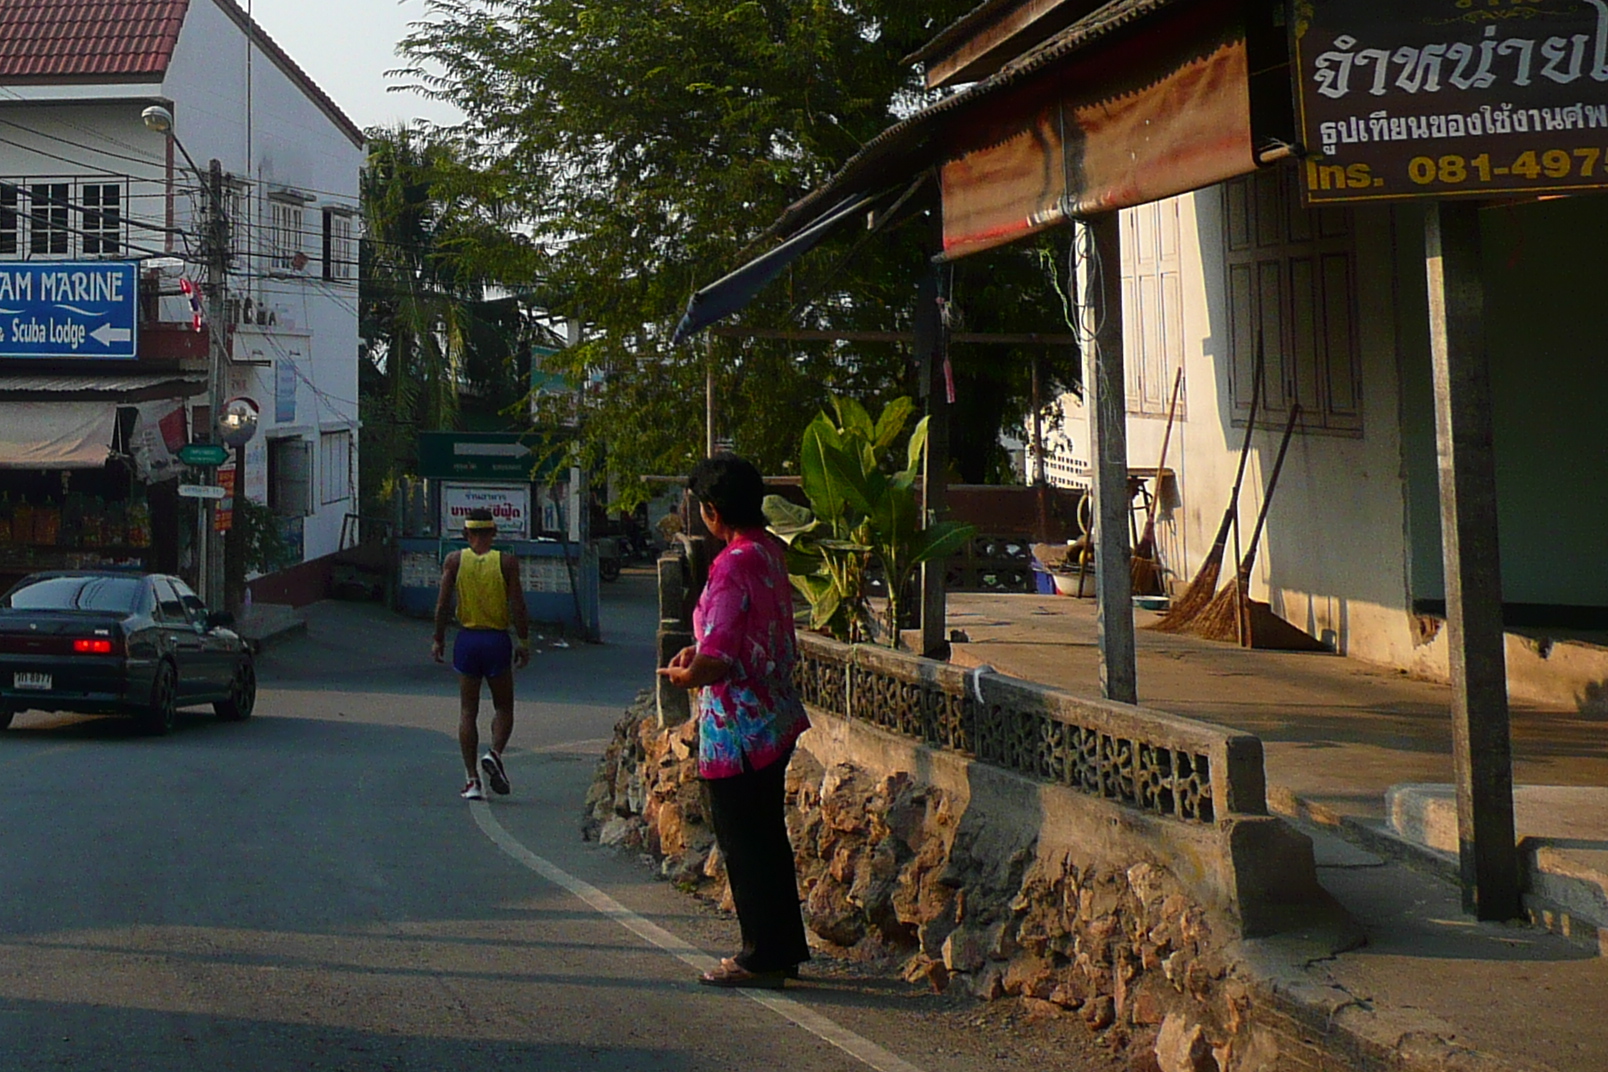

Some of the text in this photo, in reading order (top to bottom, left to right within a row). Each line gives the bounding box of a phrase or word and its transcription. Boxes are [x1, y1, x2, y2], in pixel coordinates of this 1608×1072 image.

[1407, 147, 1608, 186] 081-497
[40, 271, 125, 302] MARINE
[11, 317, 47, 344] Scuba
[49, 317, 86, 350] Lodge
